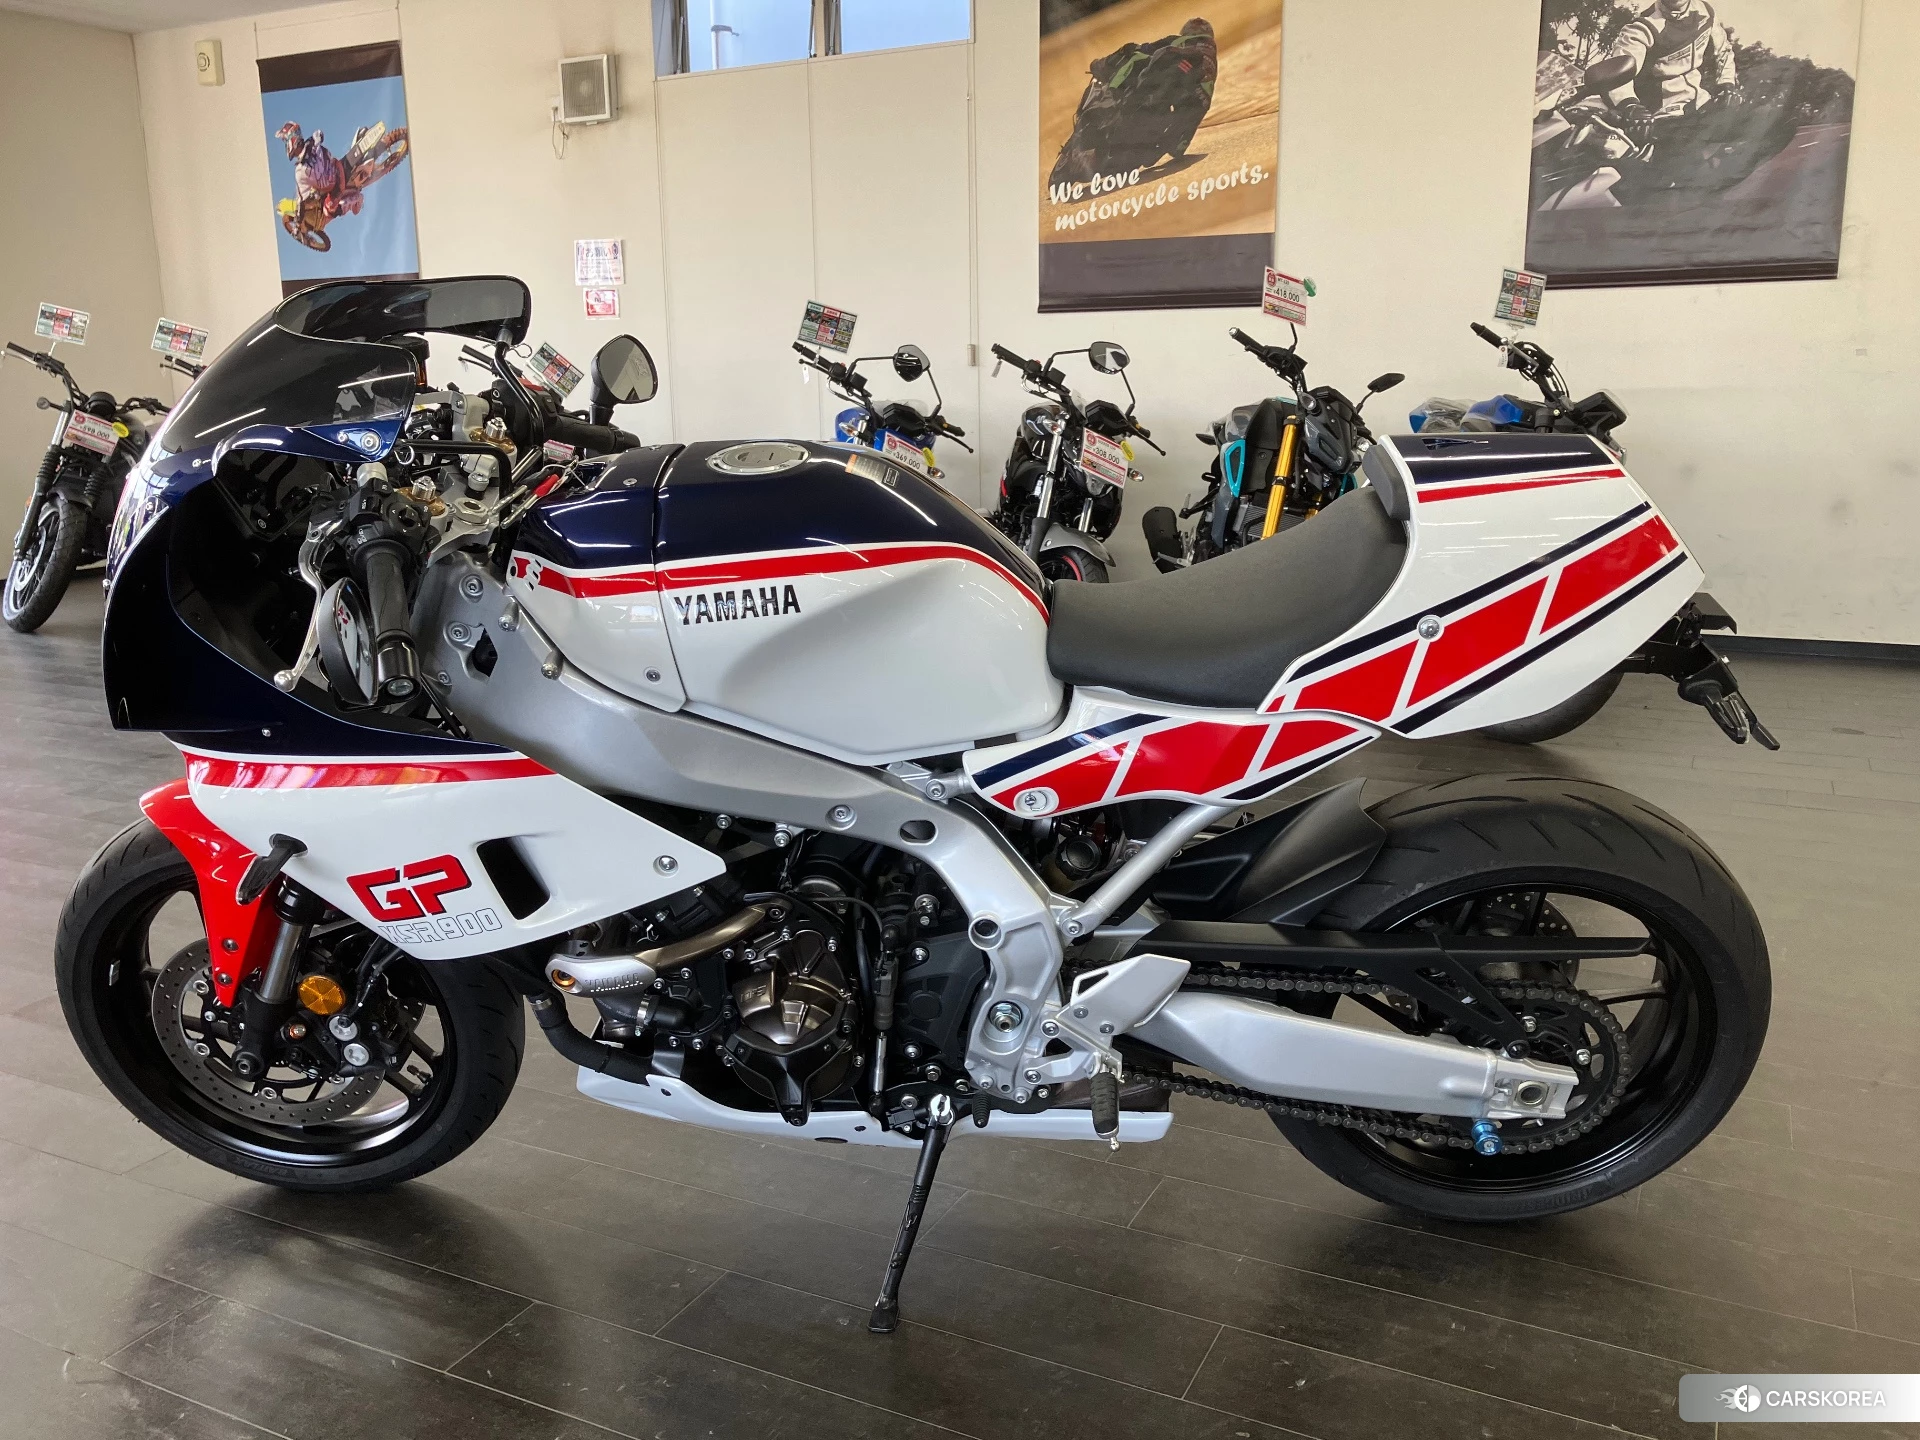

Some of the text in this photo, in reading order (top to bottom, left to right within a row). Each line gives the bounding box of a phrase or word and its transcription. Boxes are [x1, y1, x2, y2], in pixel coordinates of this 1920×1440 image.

[1049, 168, 1141, 206] We love
[1055, 162, 1270, 232] motorcycle sports.
[673, 584, 802, 626] YAMAHA
[346, 853, 473, 923] GP
[378, 907, 503, 944] XSR900
